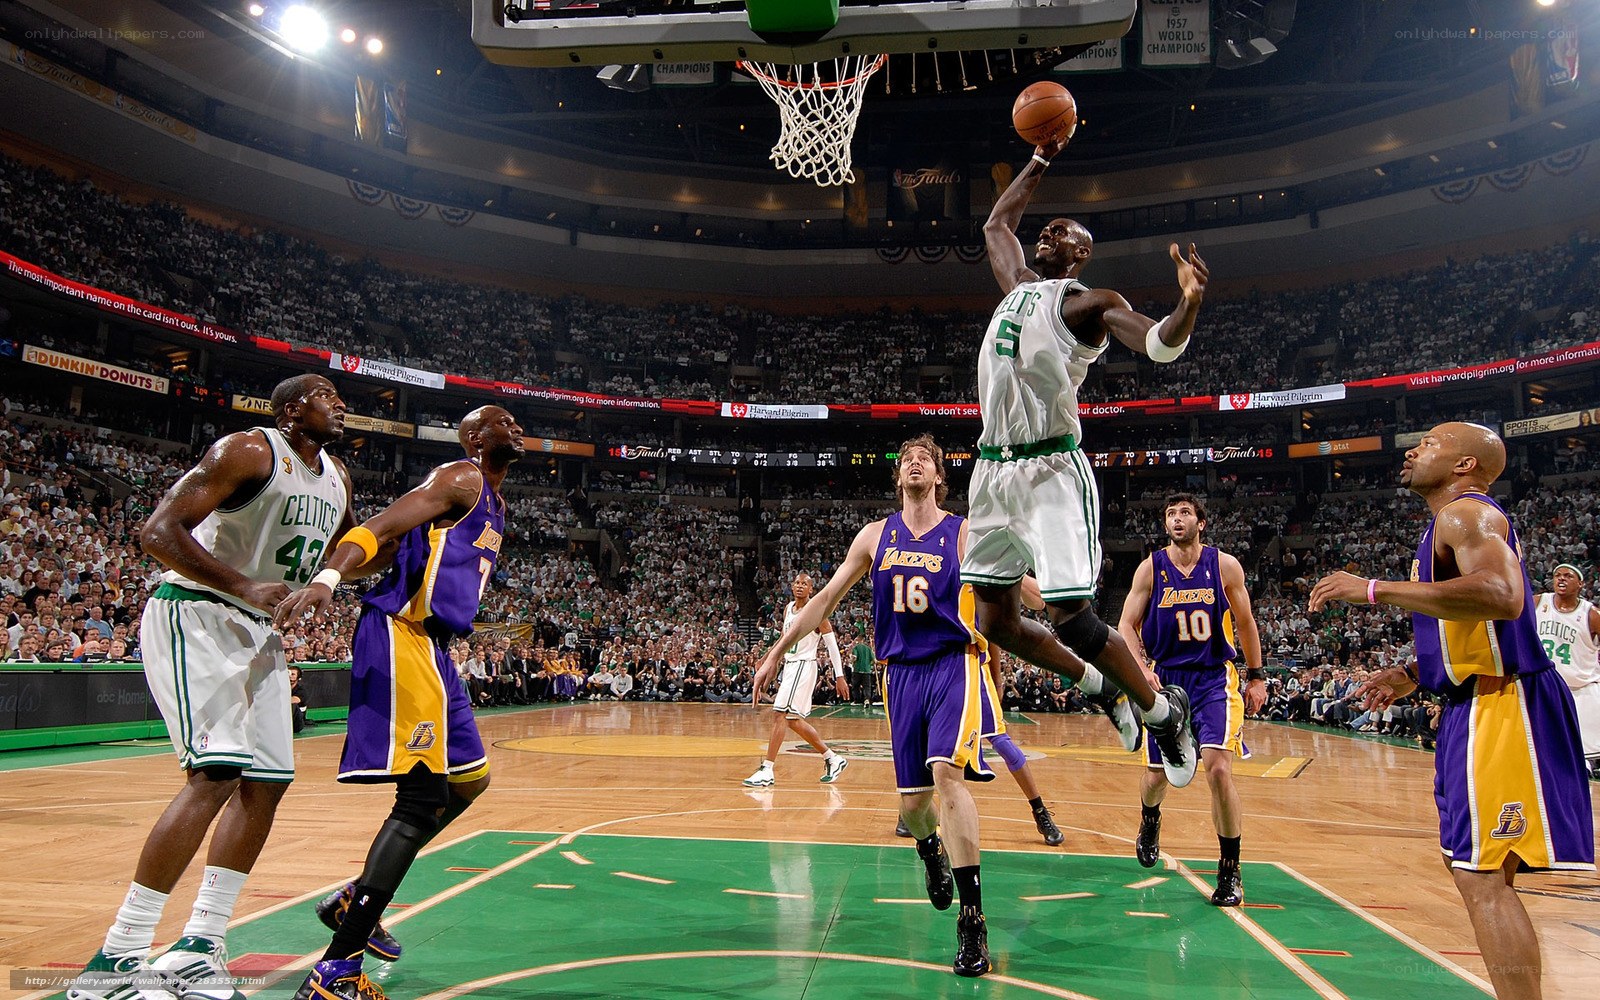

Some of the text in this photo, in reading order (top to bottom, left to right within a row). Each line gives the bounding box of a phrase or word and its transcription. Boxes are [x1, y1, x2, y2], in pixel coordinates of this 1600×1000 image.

[1167, 19, 1187, 29] 1957
[1159, 31, 1194, 41] WORLD
[1075, 47, 1118, 59] MPIONS
[1147, 43, 1206, 54] CHAMPIONS
[656, 63, 711, 75] CHAMPIONS
[912, 168, 961, 188] Finals
[8, 260, 238, 343] The most important name on the card isn't ours. It's yours.
[996, 319, 1022, 358] 5
[37, 352, 153, 389] DUNKIN' DONUTS
[364, 359, 425, 385] Harvard Pilgrim
[1410, 376, 1430, 386] Visit
[1431, 363, 1515, 384] harvardpilgrim.org
[1516, 360, 1528, 370] for
[1530, 355, 1555, 367] more
[501, 385, 661, 409] Visit harvardpilgrim.org for more information.
[1253, 392, 1323, 403] Harvard Pilgrim
[750, 406, 781, 416] Harvard
[782, 409, 809, 418] Pilgrim
[919, 406, 936, 416] You
[937, 406, 961, 415] don't
[1077, 405, 1125, 415] our doctor.
[1506, 420, 1539, 431] SPORTS
[1528, 424, 1550, 433] DESK
[635, 446, 664, 459] Finals
[952, 459, 962, 467] 10
[1222, 447, 1256, 461] Finals
[281, 494, 337, 538] CELTICS
[275, 534, 324, 584] 43
[879, 546, 944, 573] LAKERS
[479, 556, 492, 601] 7
[892, 574, 929, 614] 16
[1158, 587, 1216, 609] LAKERS
[1175, 609, 1212, 642] 10
[1539, 620, 1577, 644] CELTICS
[1541, 639, 1571, 665] 34
